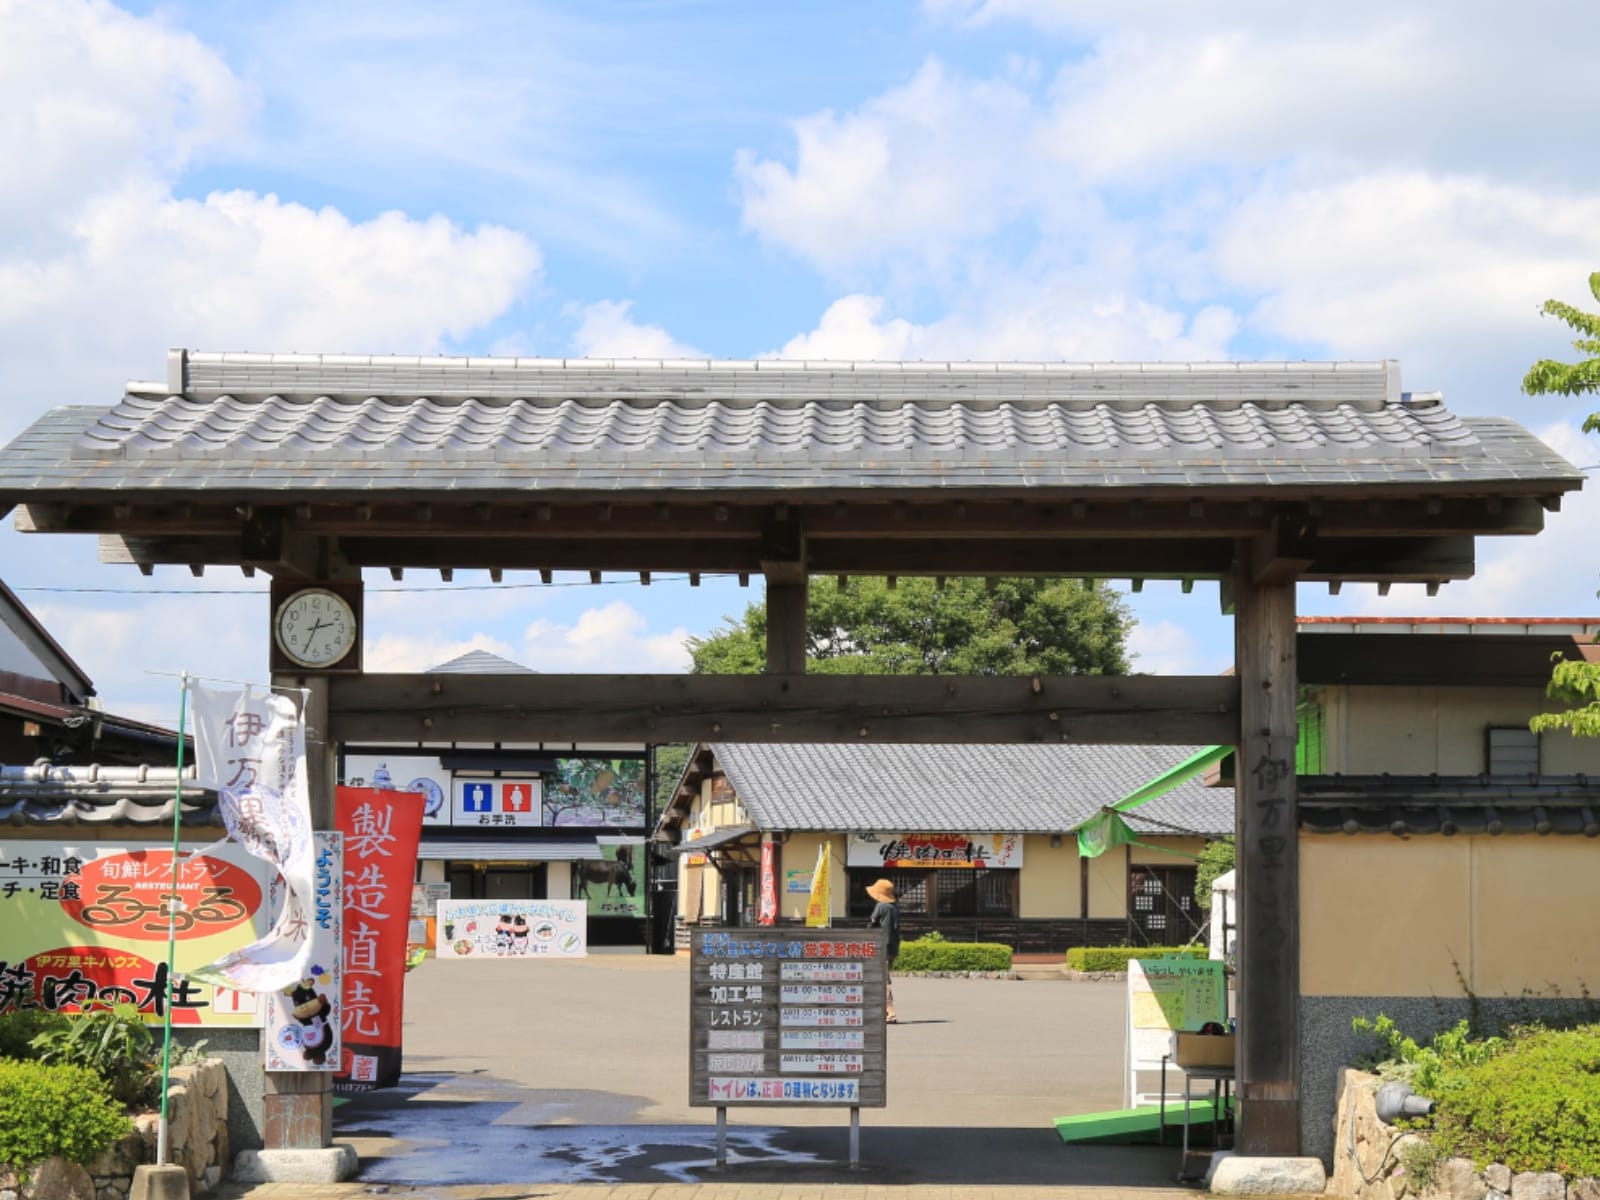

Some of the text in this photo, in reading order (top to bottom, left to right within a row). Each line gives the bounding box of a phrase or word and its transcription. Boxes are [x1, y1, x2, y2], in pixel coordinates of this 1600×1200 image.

[311, 598, 321, 609] 12
[290, 610, 299, 621] 10
[334, 610, 341, 622] 2
[286, 622, 294, 632] 9
[337, 623, 345, 634] 3
[291, 634, 297, 646] 8
[335, 635, 341, 645] 4
[312, 647, 319, 657] 6
[324, 643, 332, 655] 5
[479, 815, 516, 825] お手洗
[102, 860, 229, 880] 旬鮮レストラン
[316, 848, 333, 929] ようこそ
[343, 802, 396, 1037] 製造直売
[35, 955, 142, 968] 伊万里牛ハウス
[709, 963, 763, 980] 特産館
[709, 986, 763, 1003] 加工場
[710, 1010, 762, 1027] レストラン
